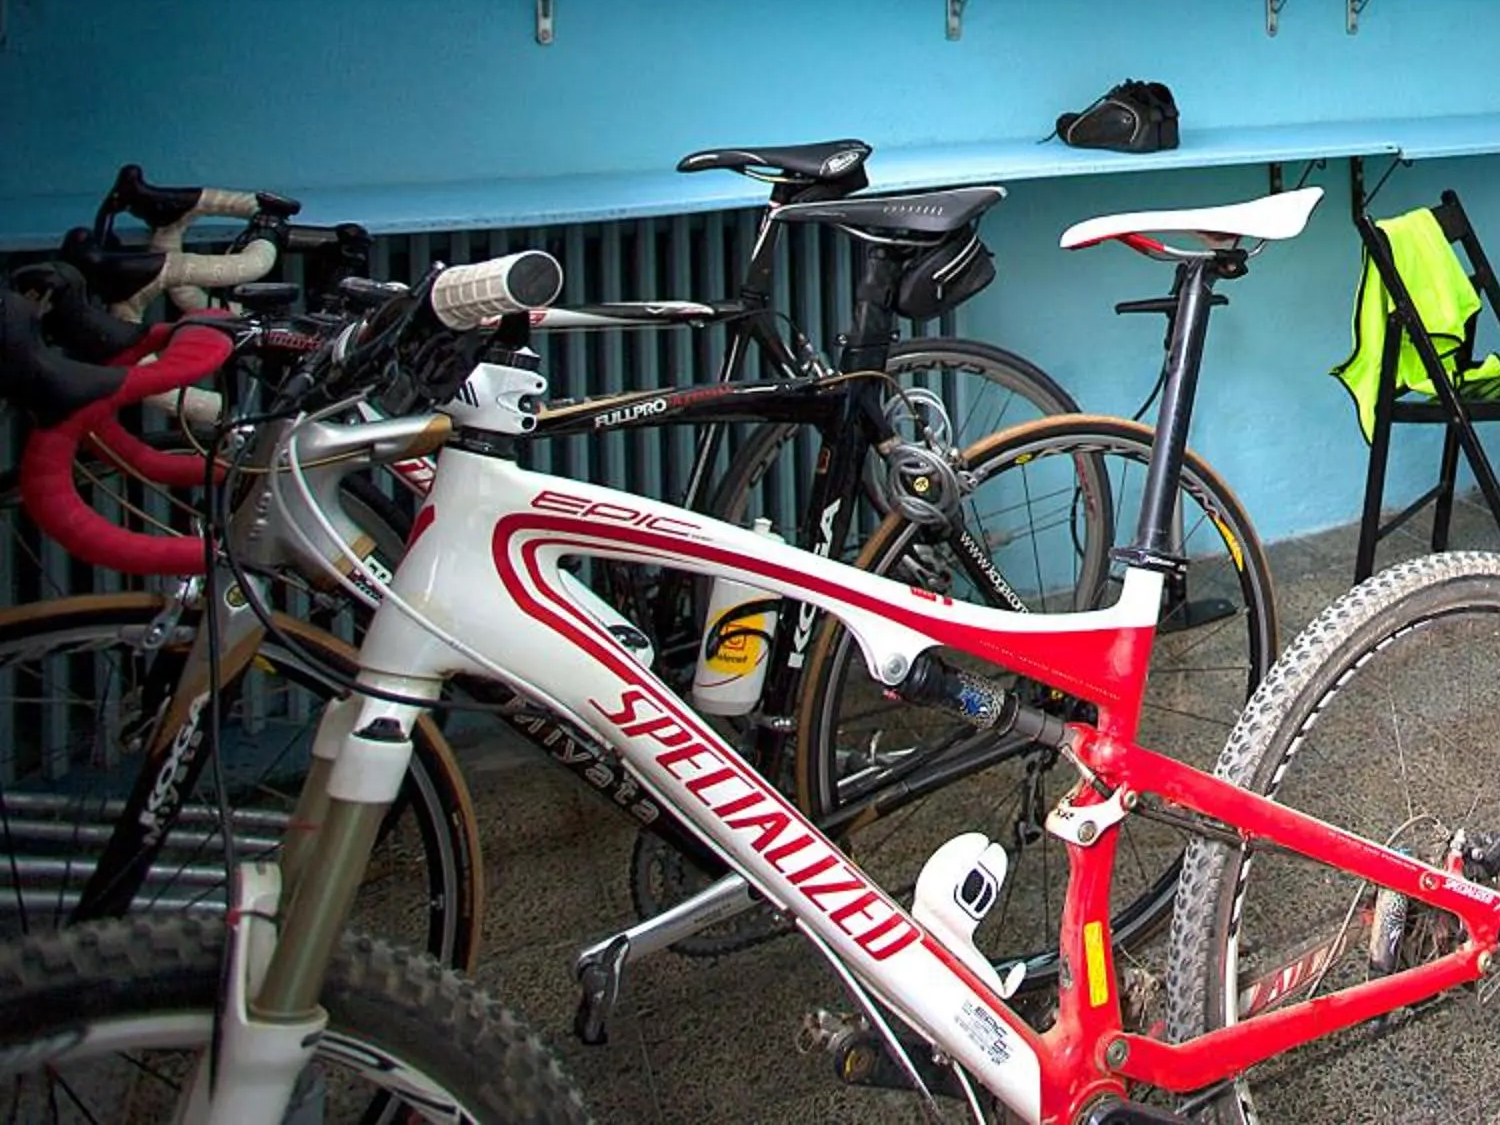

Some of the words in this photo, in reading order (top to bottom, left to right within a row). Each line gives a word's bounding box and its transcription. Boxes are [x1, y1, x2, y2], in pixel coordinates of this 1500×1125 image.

[594, 398, 667, 428] FULLPRO
[531, 490, 701, 537] EPIC
[589, 689, 926, 962] SPECIALIZED
